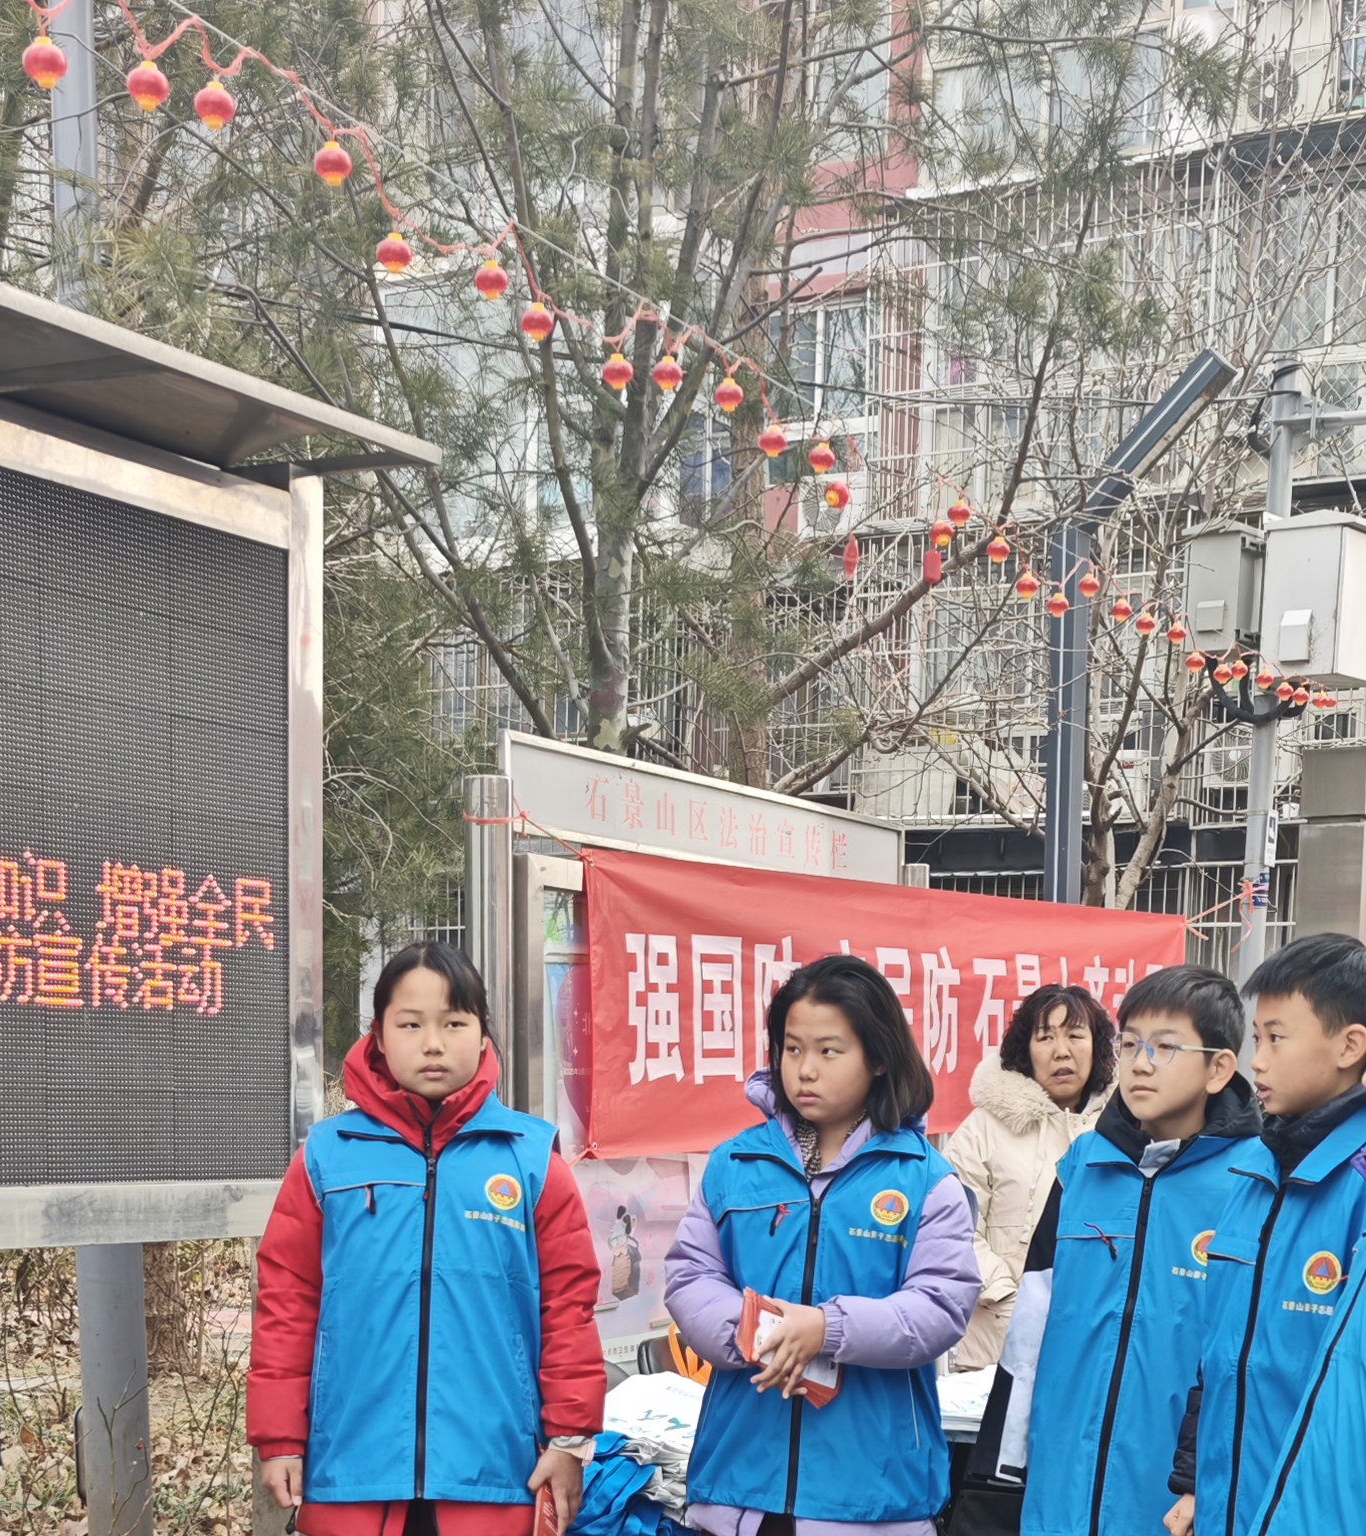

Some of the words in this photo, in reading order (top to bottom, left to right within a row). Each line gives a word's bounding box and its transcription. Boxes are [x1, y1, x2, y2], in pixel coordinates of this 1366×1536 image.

[585, 776, 848, 870] 石景山区法治宣传栏
